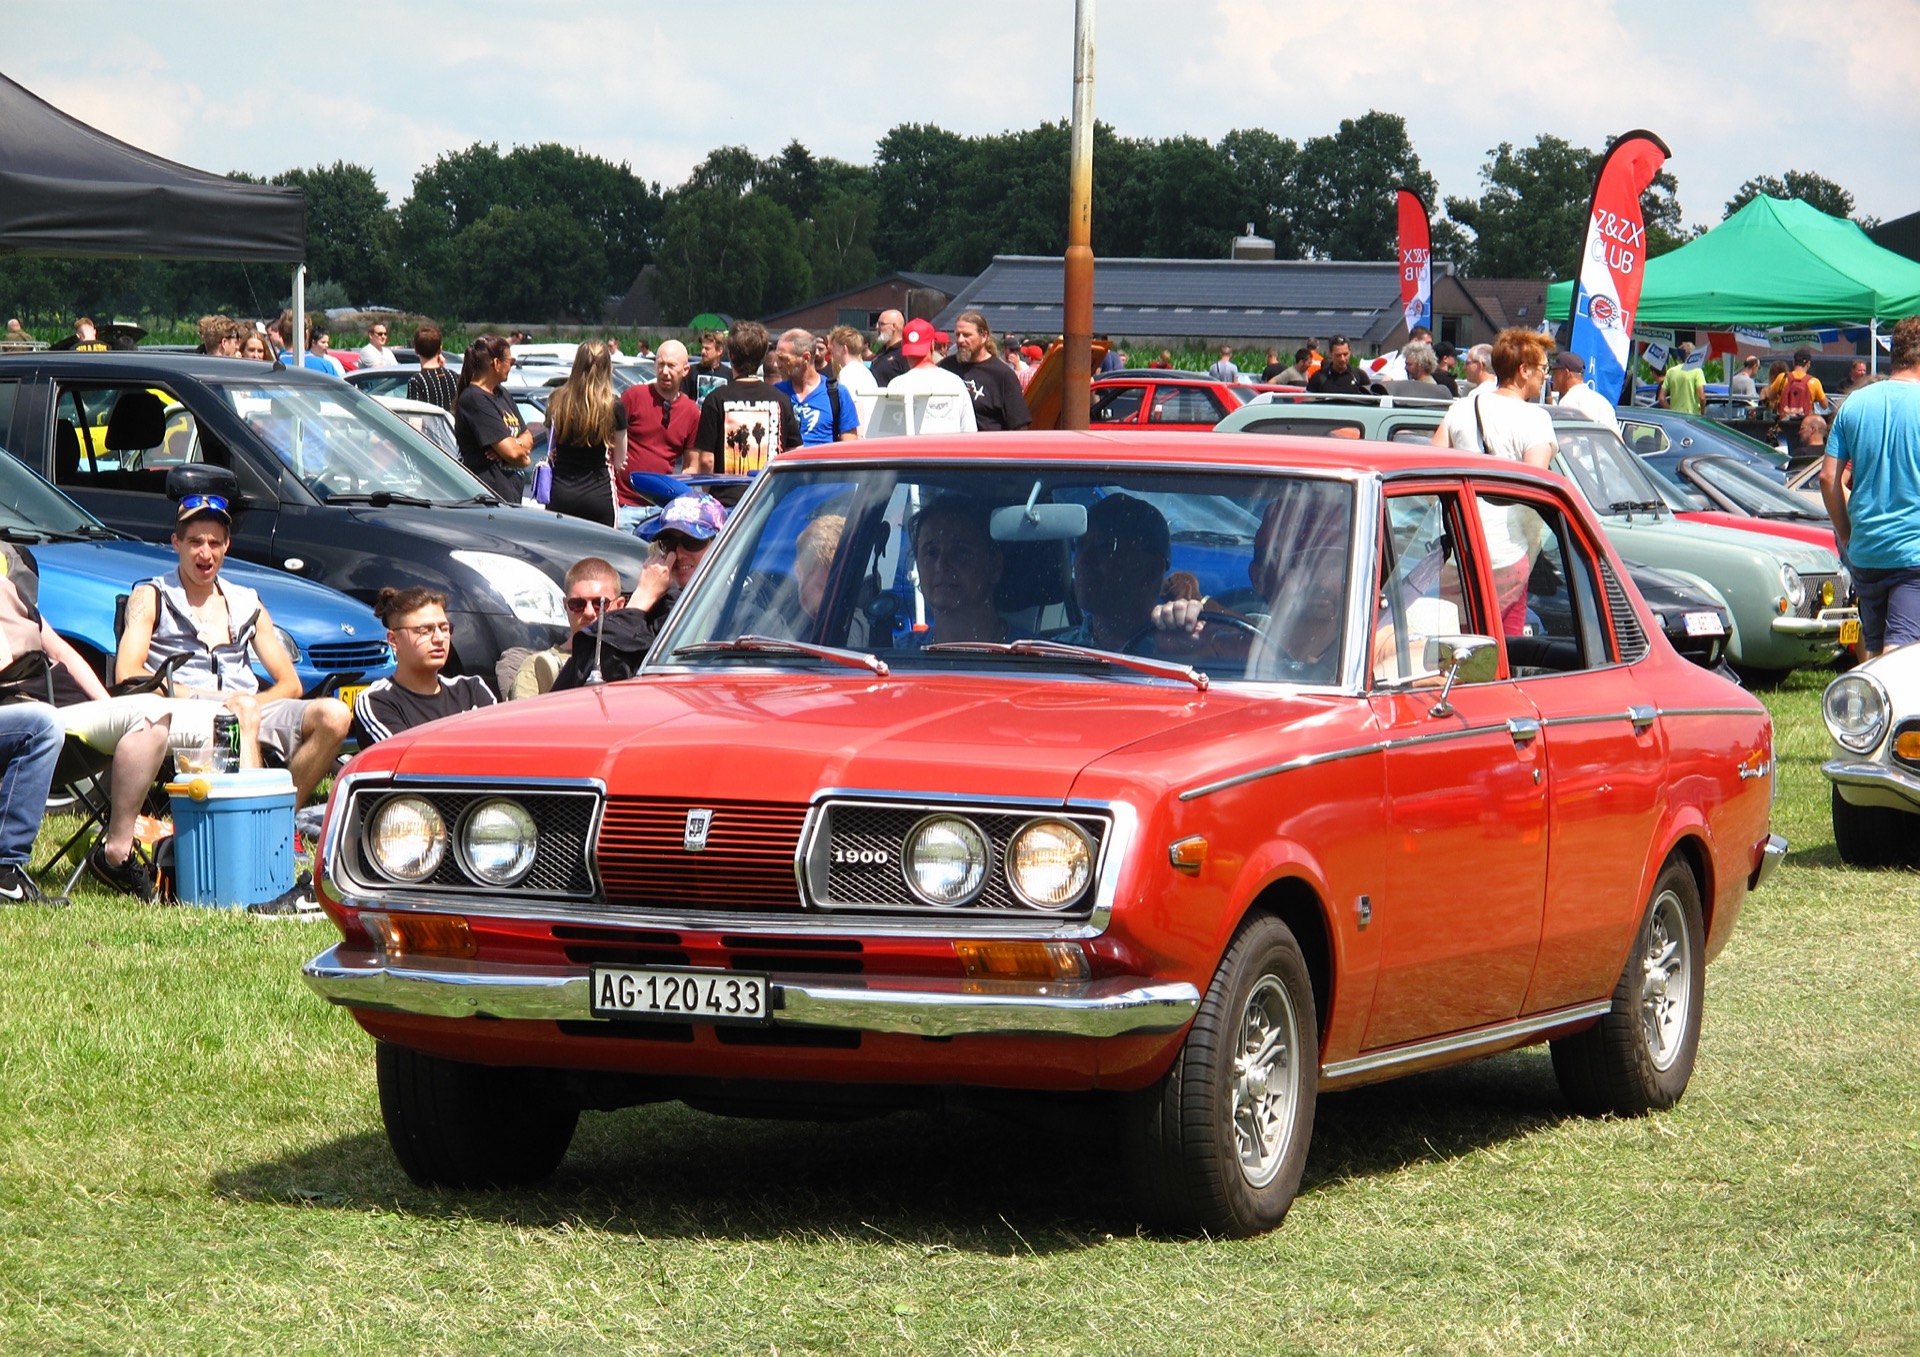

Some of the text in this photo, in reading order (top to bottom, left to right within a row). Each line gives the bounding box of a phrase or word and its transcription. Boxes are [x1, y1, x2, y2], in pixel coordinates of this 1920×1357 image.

[1595, 209, 1644, 248] Z&ZX
[1591, 237, 1635, 274] CLUB
[1635, 329, 1671, 340] NISSAN
[1783, 335, 1819, 343] NISSAN
[835, 850, 888, 864] 1900
